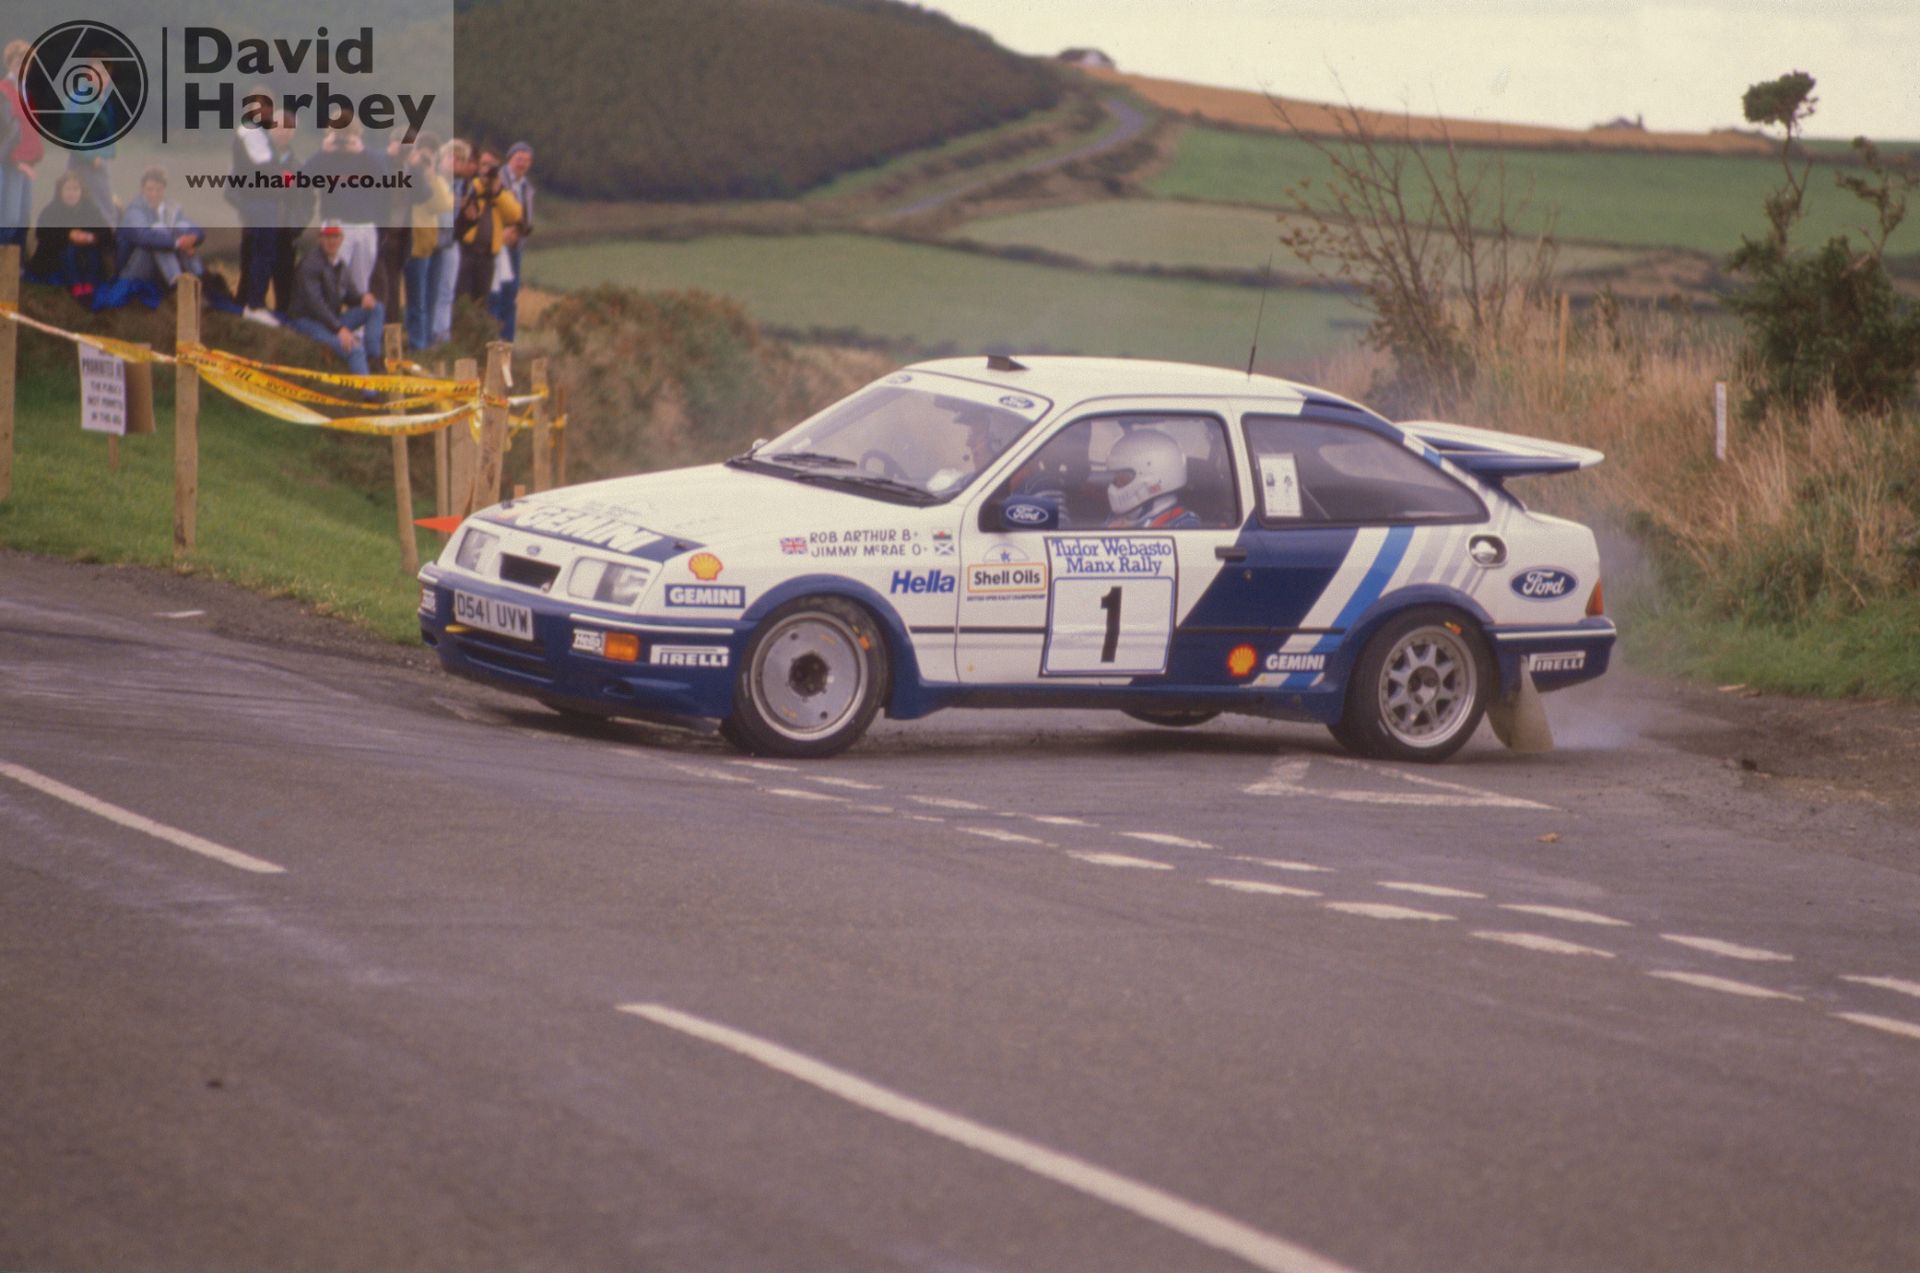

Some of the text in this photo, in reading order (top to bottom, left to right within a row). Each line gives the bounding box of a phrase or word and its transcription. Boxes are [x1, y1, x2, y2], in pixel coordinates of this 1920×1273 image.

[1010, 504, 1040, 521] Ford
[809, 531, 838, 544] ROB
[843, 529, 897, 543] ARTHUR
[811, 545, 858, 558] JIMMY
[1052, 538, 1172, 557] Tudor Webasto
[1066, 557, 1163, 577] Manx Rally
[890, 569, 956, 594] Hella
[974, 570, 1041, 585] Shell Oils
[1522, 571, 1566, 596] Ford
[669, 586, 742, 606] GEMINI
[456, 593, 491, 624] D541
[497, 604, 529, 634] UVW
[1101, 586, 1122, 663] 1
[650, 645, 729, 667] PIRELLI
[1265, 654, 1325, 671] GEMINI
[1529, 651, 1586, 672] PIRELLI
